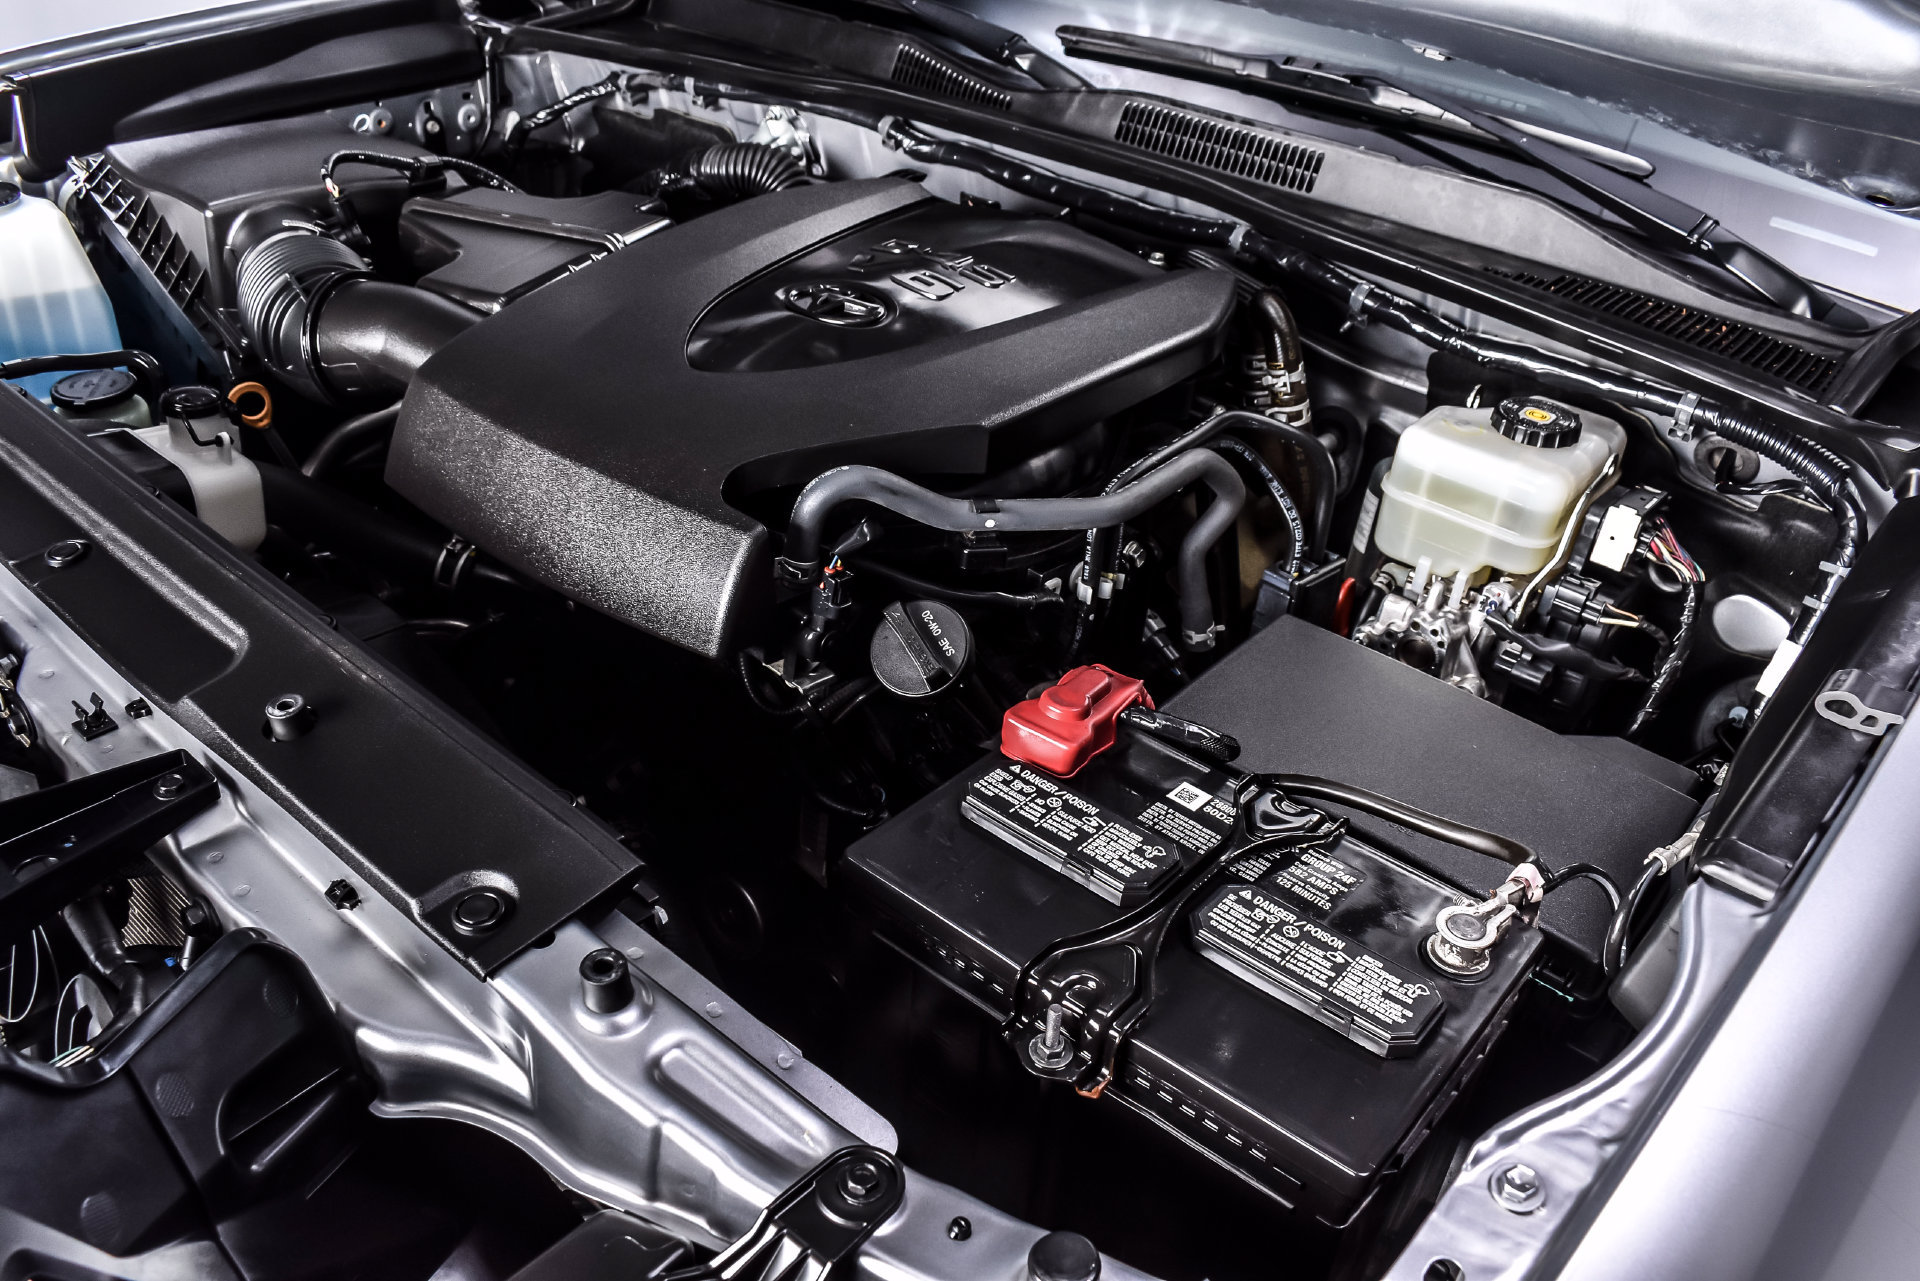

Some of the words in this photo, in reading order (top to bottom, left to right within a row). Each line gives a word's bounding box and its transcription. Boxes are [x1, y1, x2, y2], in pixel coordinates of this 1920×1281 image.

[922, 610, 942, 636] 0W-20
[938, 638, 956, 656] SAE
[1021, 770, 1058, 793] DANGER
[1062, 794, 1099, 815] POISON
[1238, 872, 1255, 882] GUAM
[1288, 866, 1308, 878] 582
[1307, 876, 1341, 894] AMPS
[1295, 862, 1308, 870] Cold
[1308, 869, 1332, 883] Cranking
[1330, 882, 1348, 892] Amps
[1301, 854, 1336, 873] GROUP
[1332, 871, 1356, 884] 24F
[1277, 877, 1292, 888] 125
[1292, 885, 1331, 909] MINUTES
[1282, 873, 1304, 886] Reserve
[1306, 885, 1329, 900] Capacity
[1253, 896, 1297, 924] DANGER
[1304, 924, 1346, 952] POISON
